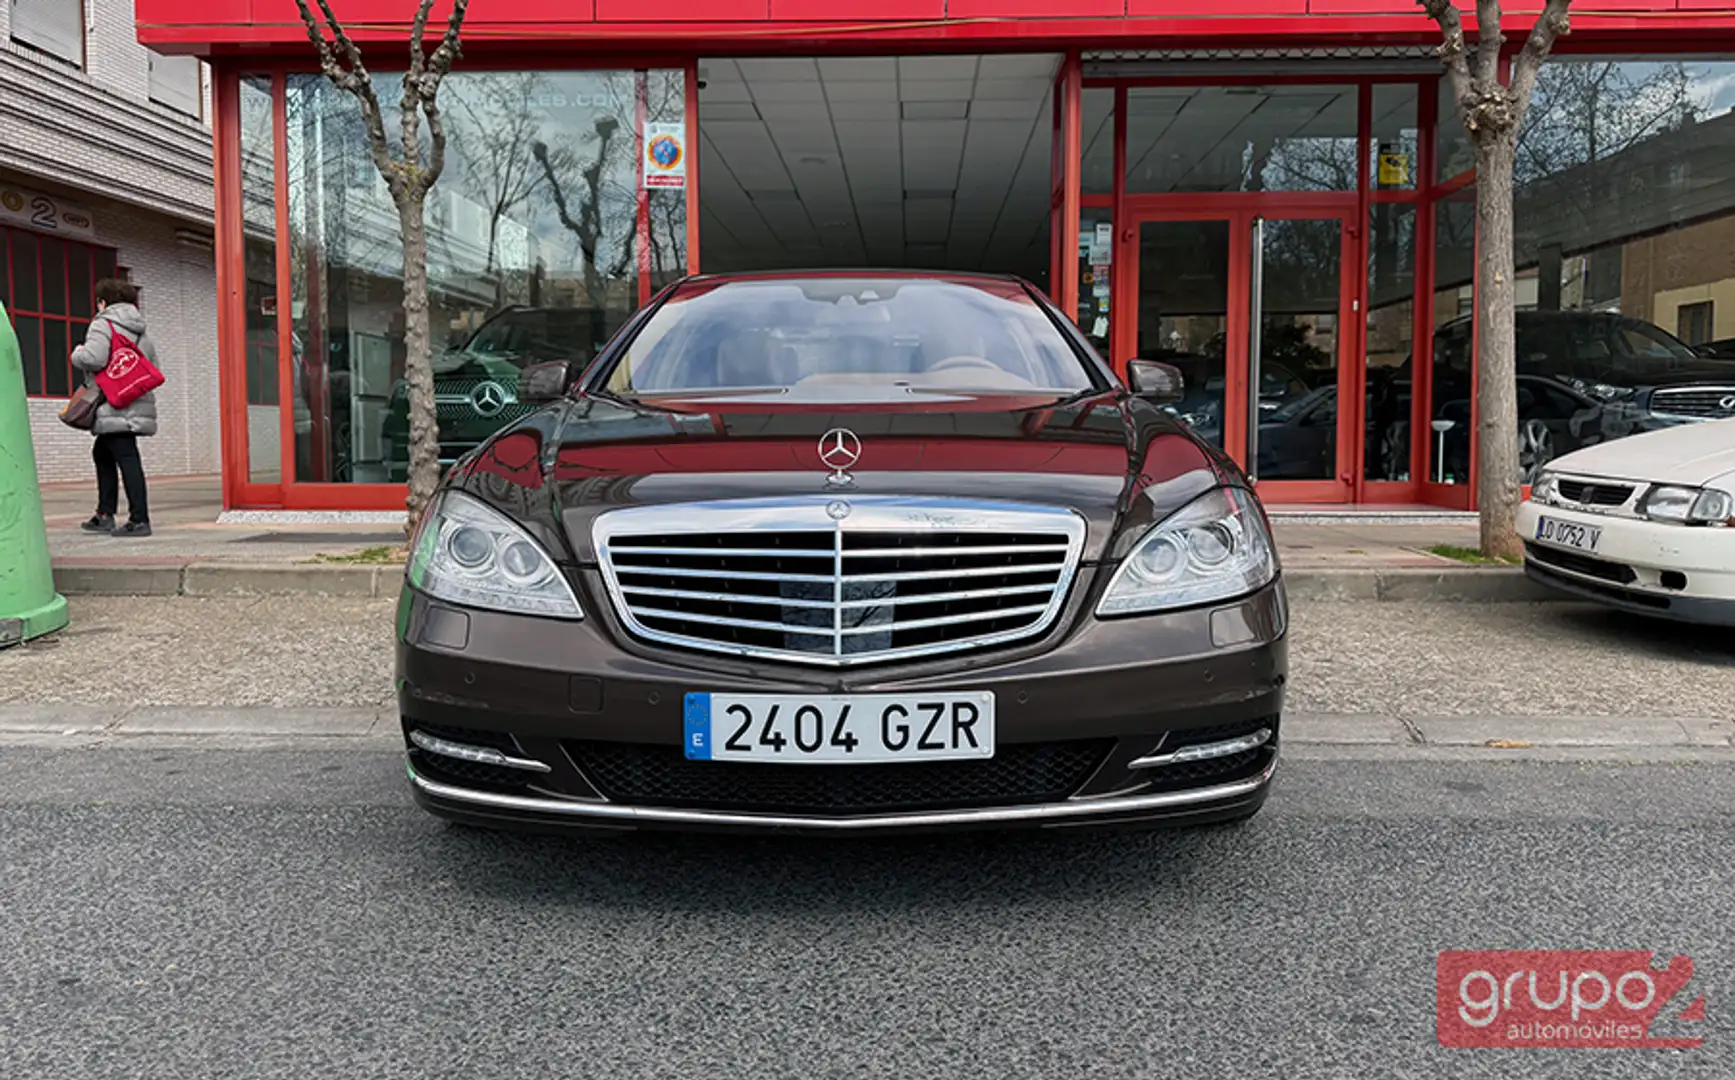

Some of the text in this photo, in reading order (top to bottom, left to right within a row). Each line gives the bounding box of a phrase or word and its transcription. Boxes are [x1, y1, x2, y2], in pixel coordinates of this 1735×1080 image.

[30, 196, 58, 229] 2
[1556, 522, 1586, 547] 0752
[1590, 529, 1602, 549] V
[691, 732, 705, 748] E
[725, 702, 980, 753] 2404 GZR
